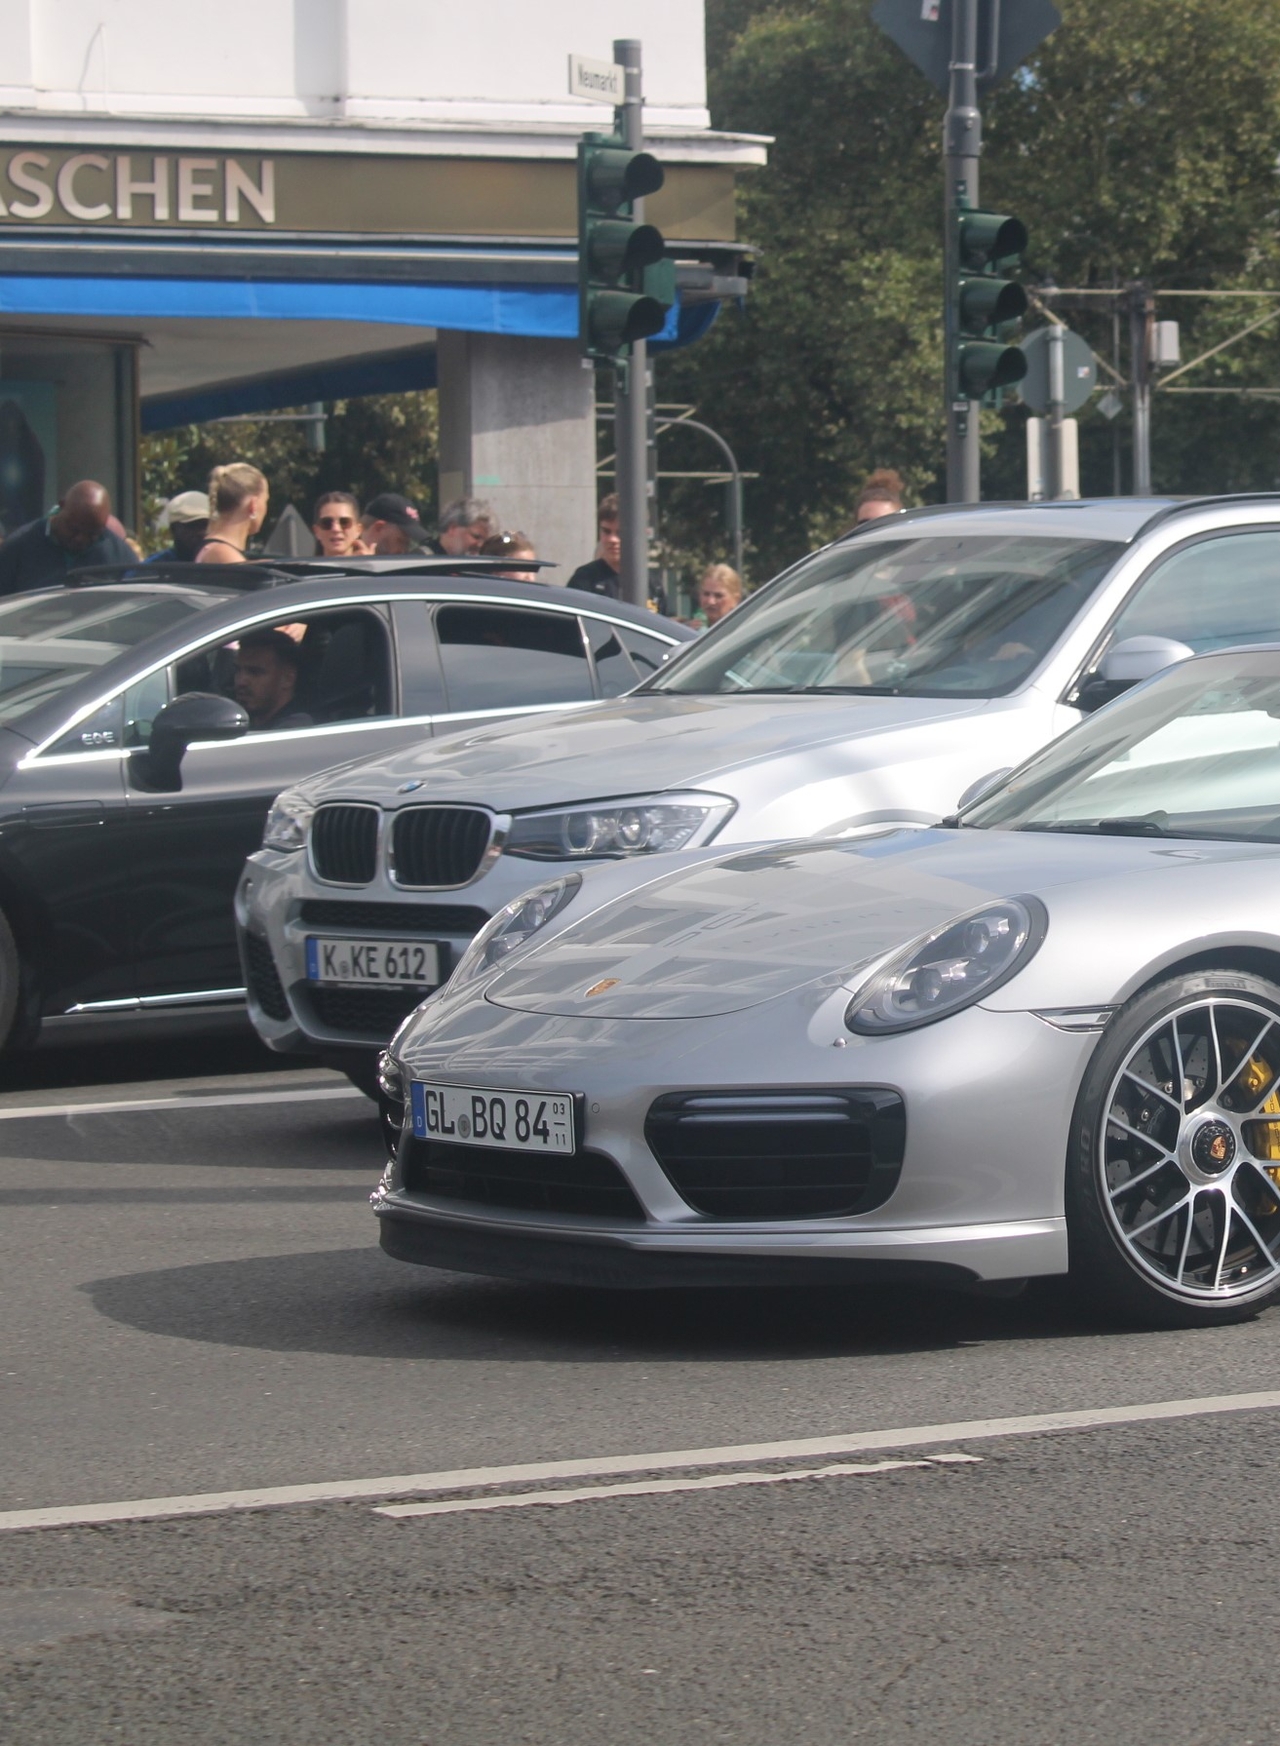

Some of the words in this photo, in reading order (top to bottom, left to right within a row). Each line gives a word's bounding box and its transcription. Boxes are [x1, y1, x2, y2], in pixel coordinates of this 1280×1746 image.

[578, 63, 617, 94] Neumarkt
[0, 151, 275, 223] SCHEN
[323, 944, 338, 977] K
[351, 945, 380, 978] KE
[385, 946, 427, 981] 612
[425, 1090, 455, 1134] GL
[471, 1095, 506, 1141] BQ
[515, 1099, 550, 1144] 84
[553, 1102, 565, 1115] 03
